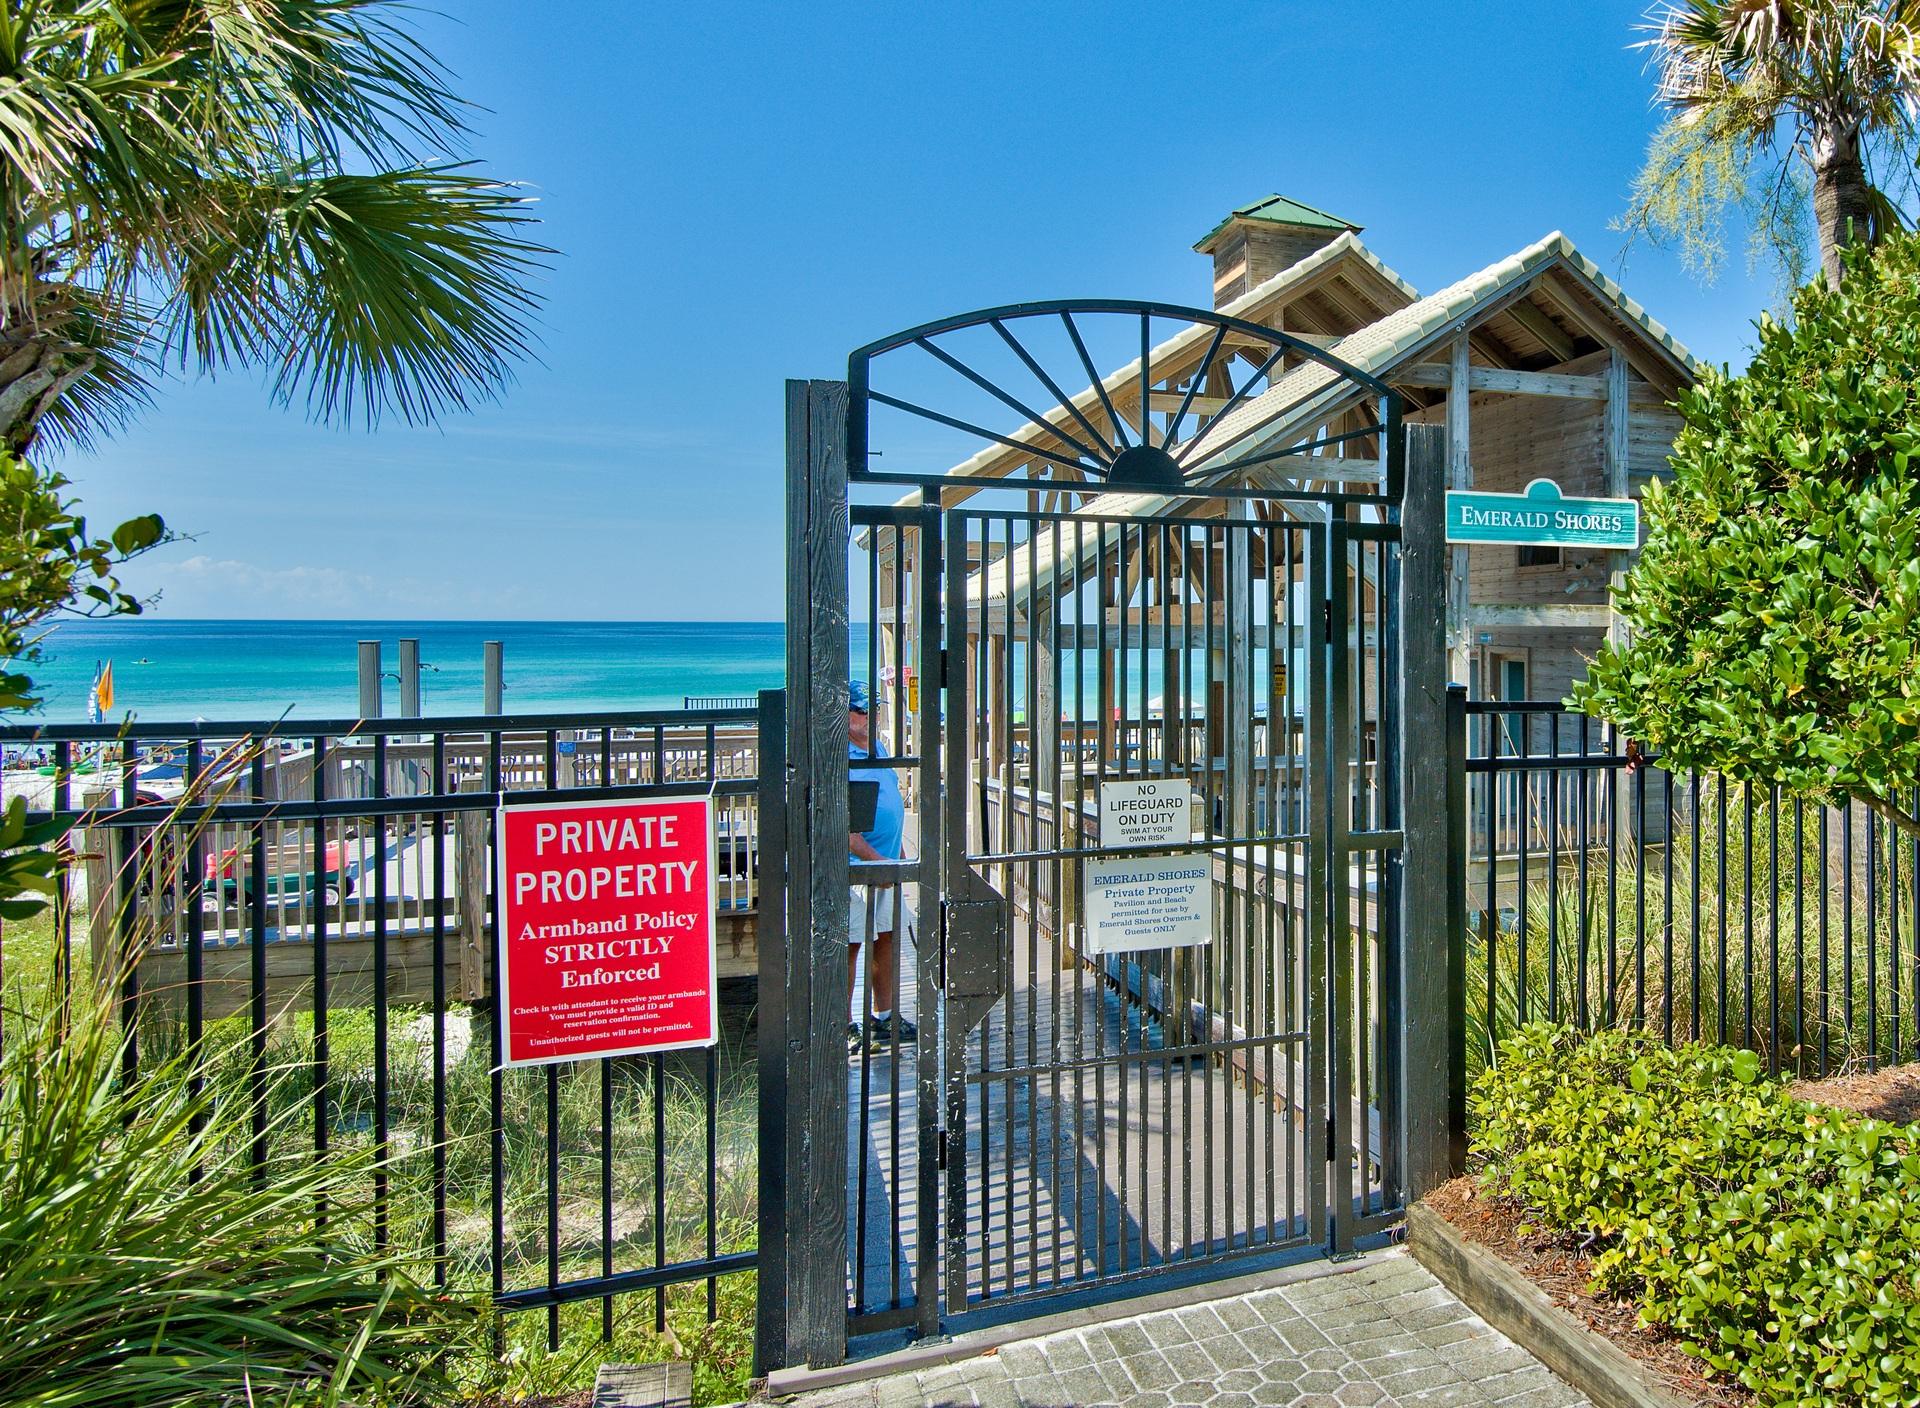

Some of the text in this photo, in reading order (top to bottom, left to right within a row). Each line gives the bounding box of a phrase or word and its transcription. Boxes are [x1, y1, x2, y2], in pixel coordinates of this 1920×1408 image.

[1461, 505, 1622, 531] EMERALD SHORES
[1138, 785, 1156, 795] NO
[1110, 798, 1183, 811] LIFEGUARD
[1119, 813, 1175, 825] ON DUTY
[536, 816, 678, 855] PRIVATE
[515, 860, 698, 905] PROPERTY
[1094, 869, 1205, 886] EMERALD SHORES
[1105, 884, 1195, 898] Private Property
[1111, 909, 1149, 918] permitted
[1151, 907, 1162, 915] for
[1180, 905, 1188, 913] by
[1114, 900, 1145, 908] Pavilion
[518, 911, 698, 941] Armband Policy
[1099, 919, 1132, 928] Emerald
[1134, 917, 1161, 925] Shores
[1125, 925, 1176, 935] Guests ONLY
[544, 936, 674, 965] STRICTLY
[561, 963, 660, 988] Enforced
[514, 1007, 539, 1015] Check
[552, 1003, 569, 1011] with
[571, 999, 609, 1009] attendant
[620, 996, 647, 1004] receive
[649, 993, 666, 1003] your
[667, 989, 705, 1000] armbands
[549, 1013, 565, 1021] You
[567, 1011, 586, 1019] must
[589, 1008, 618, 1018] provide
[626, 1004, 645, 1012] valid
[659, 1001, 673, 1009] and
[563, 1012, 660, 1028] reservation confirmation.
[530, 1034, 584, 1046] Unauthorized
[586, 1031, 610, 1041] guests
[653, 1022, 693, 1033] permitted.
